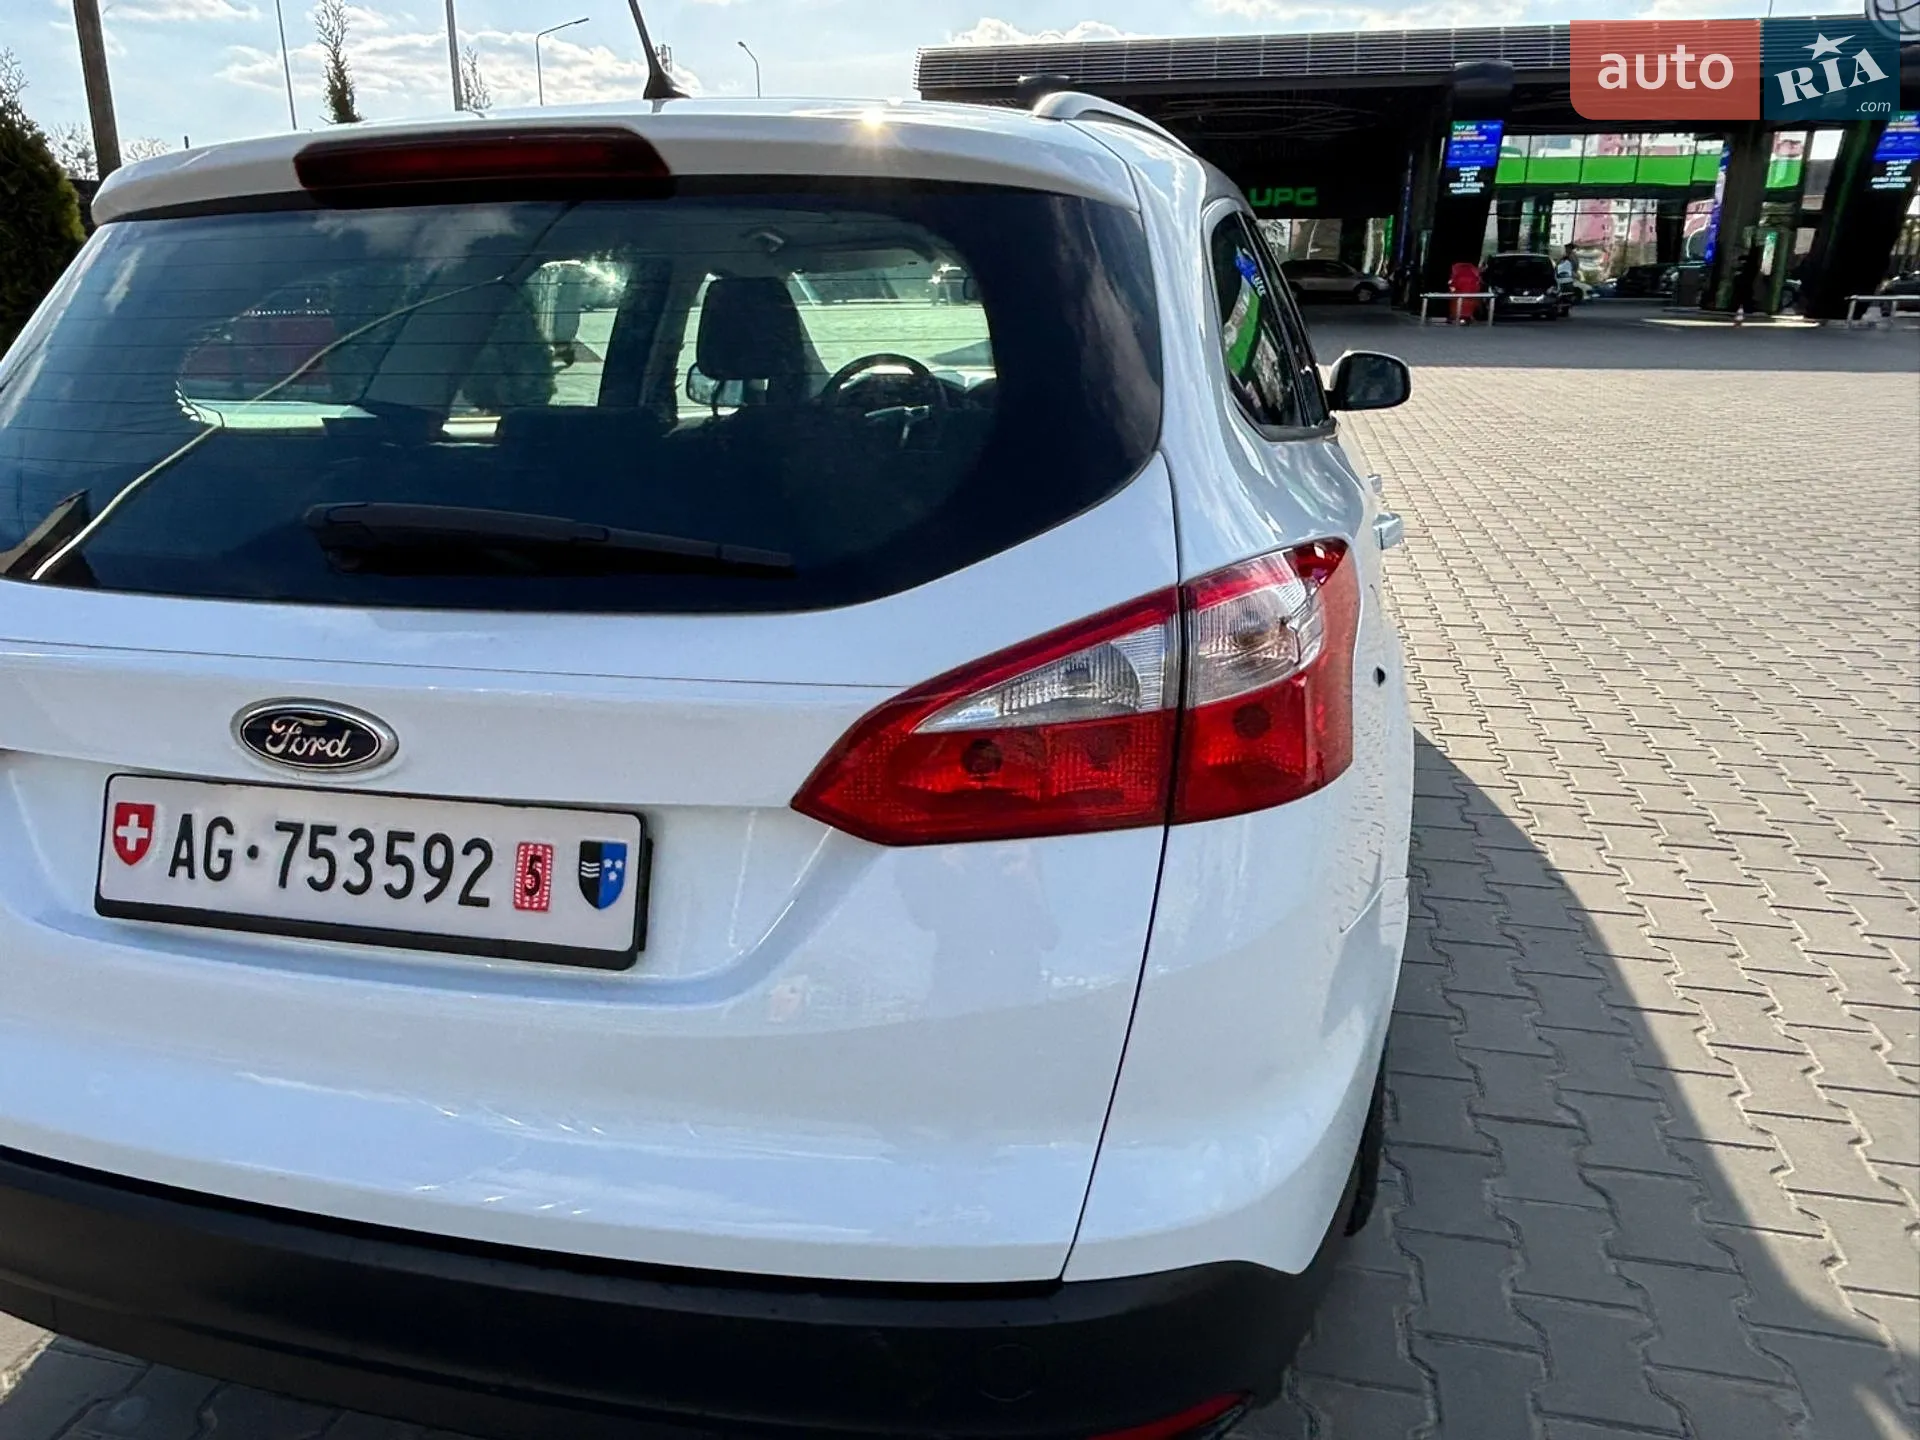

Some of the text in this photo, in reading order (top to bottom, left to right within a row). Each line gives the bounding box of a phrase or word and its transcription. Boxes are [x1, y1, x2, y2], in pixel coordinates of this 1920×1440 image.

[1249, 186, 1318, 207] UPG
[265, 715, 352, 759] Ford
[525, 854, 543, 897] 5
